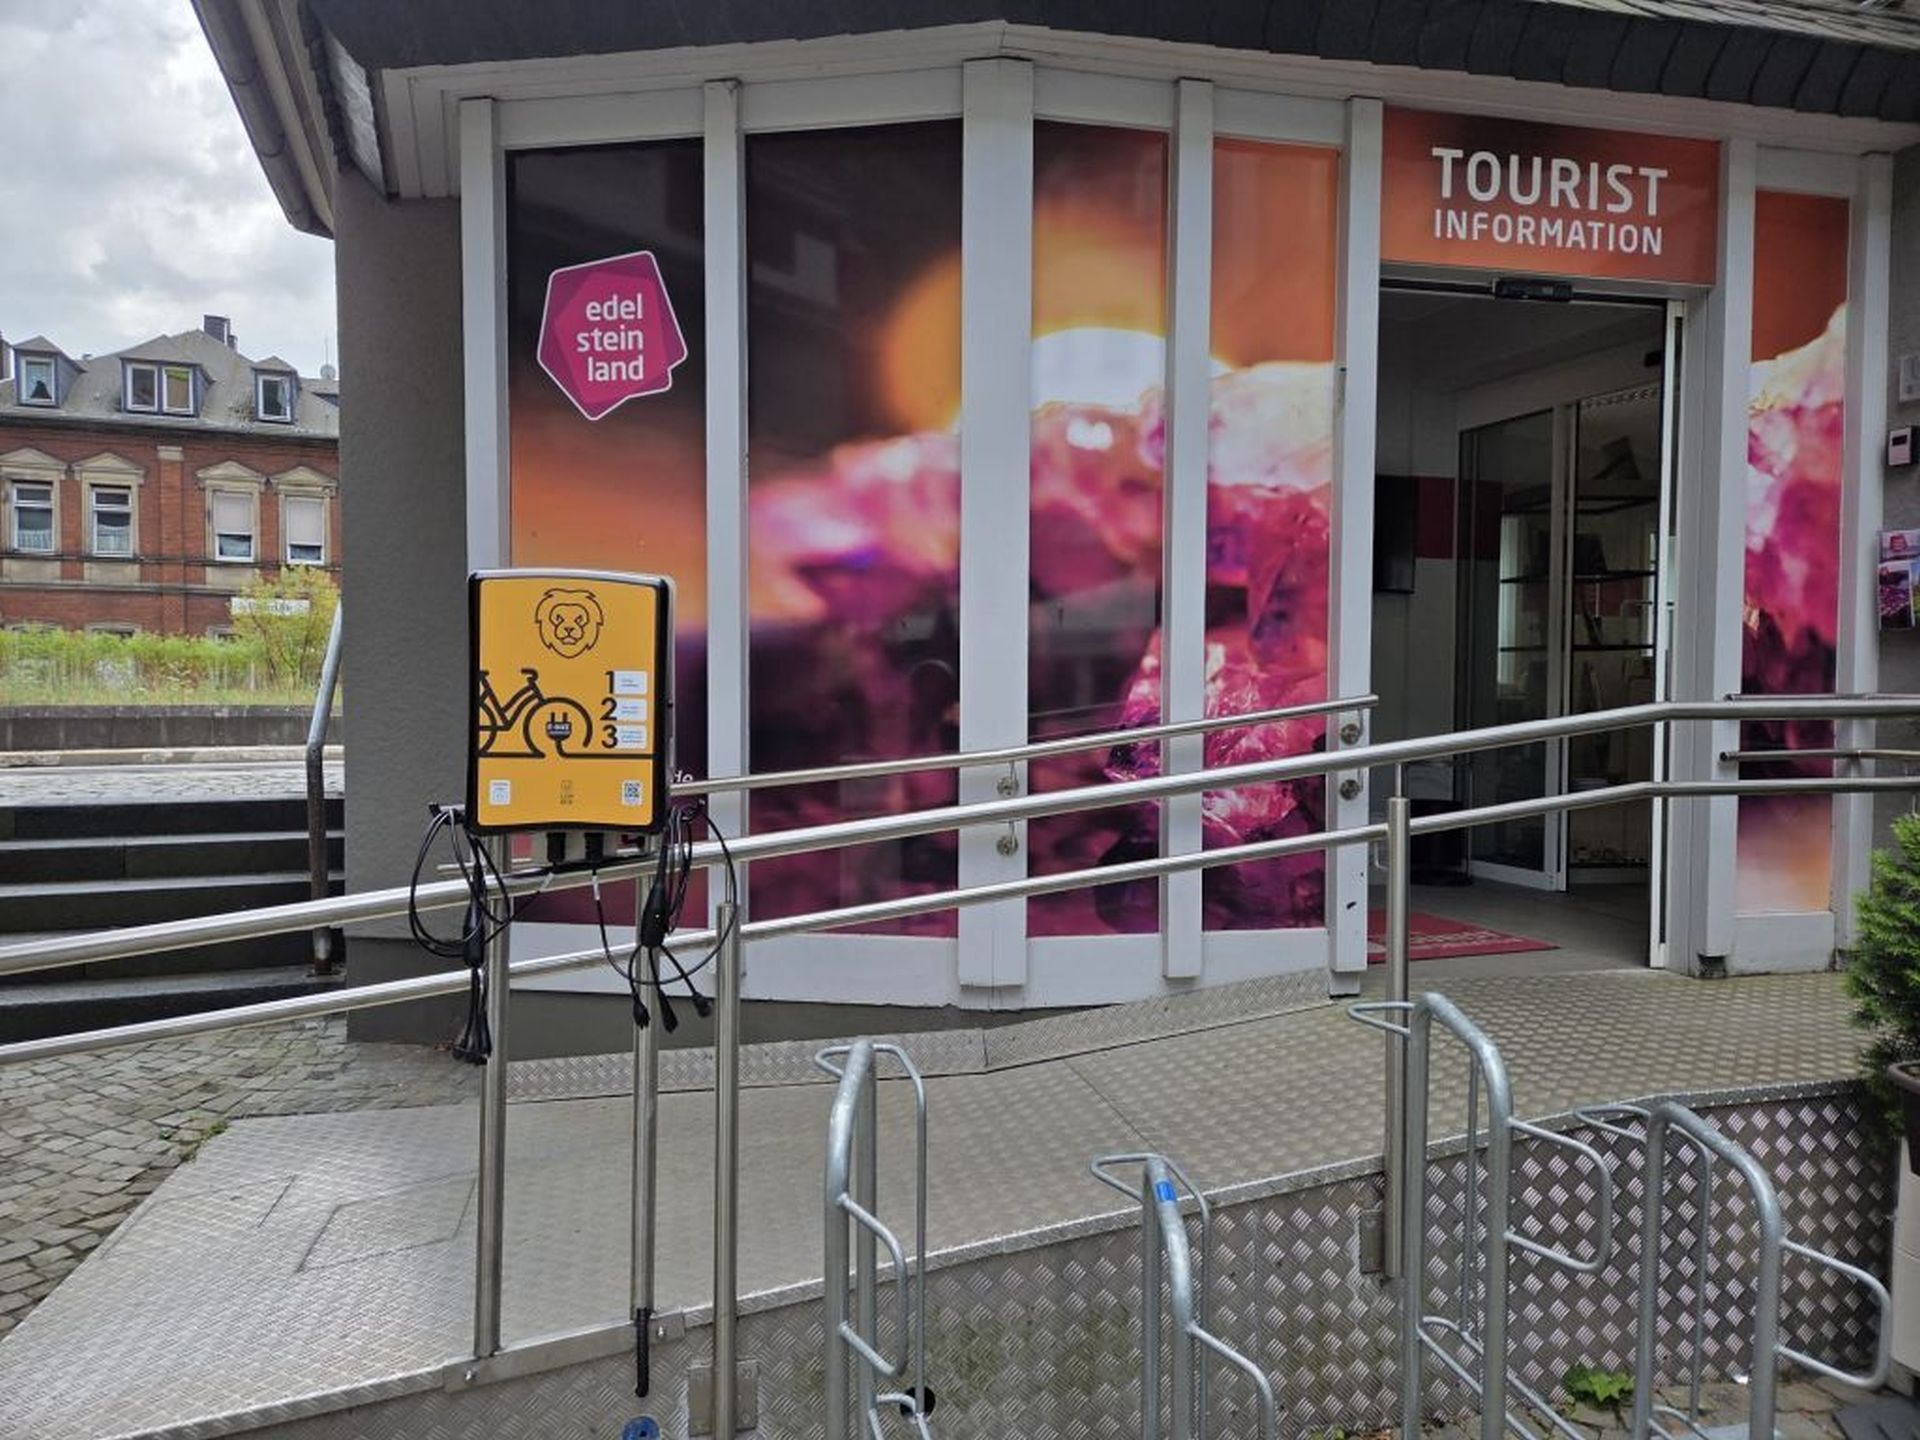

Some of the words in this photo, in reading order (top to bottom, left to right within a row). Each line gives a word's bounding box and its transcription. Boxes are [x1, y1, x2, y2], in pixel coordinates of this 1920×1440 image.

[1432, 147, 1668, 216] TOURIST
[1434, 208, 1662, 255] INFORMATION
[586, 292, 643, 321] edel
[577, 324, 644, 352] stein
[587, 355, 644, 382] land
[605, 670, 614, 694] 1
[600, 697, 617, 721] 2
[601, 725, 618, 749] 3
